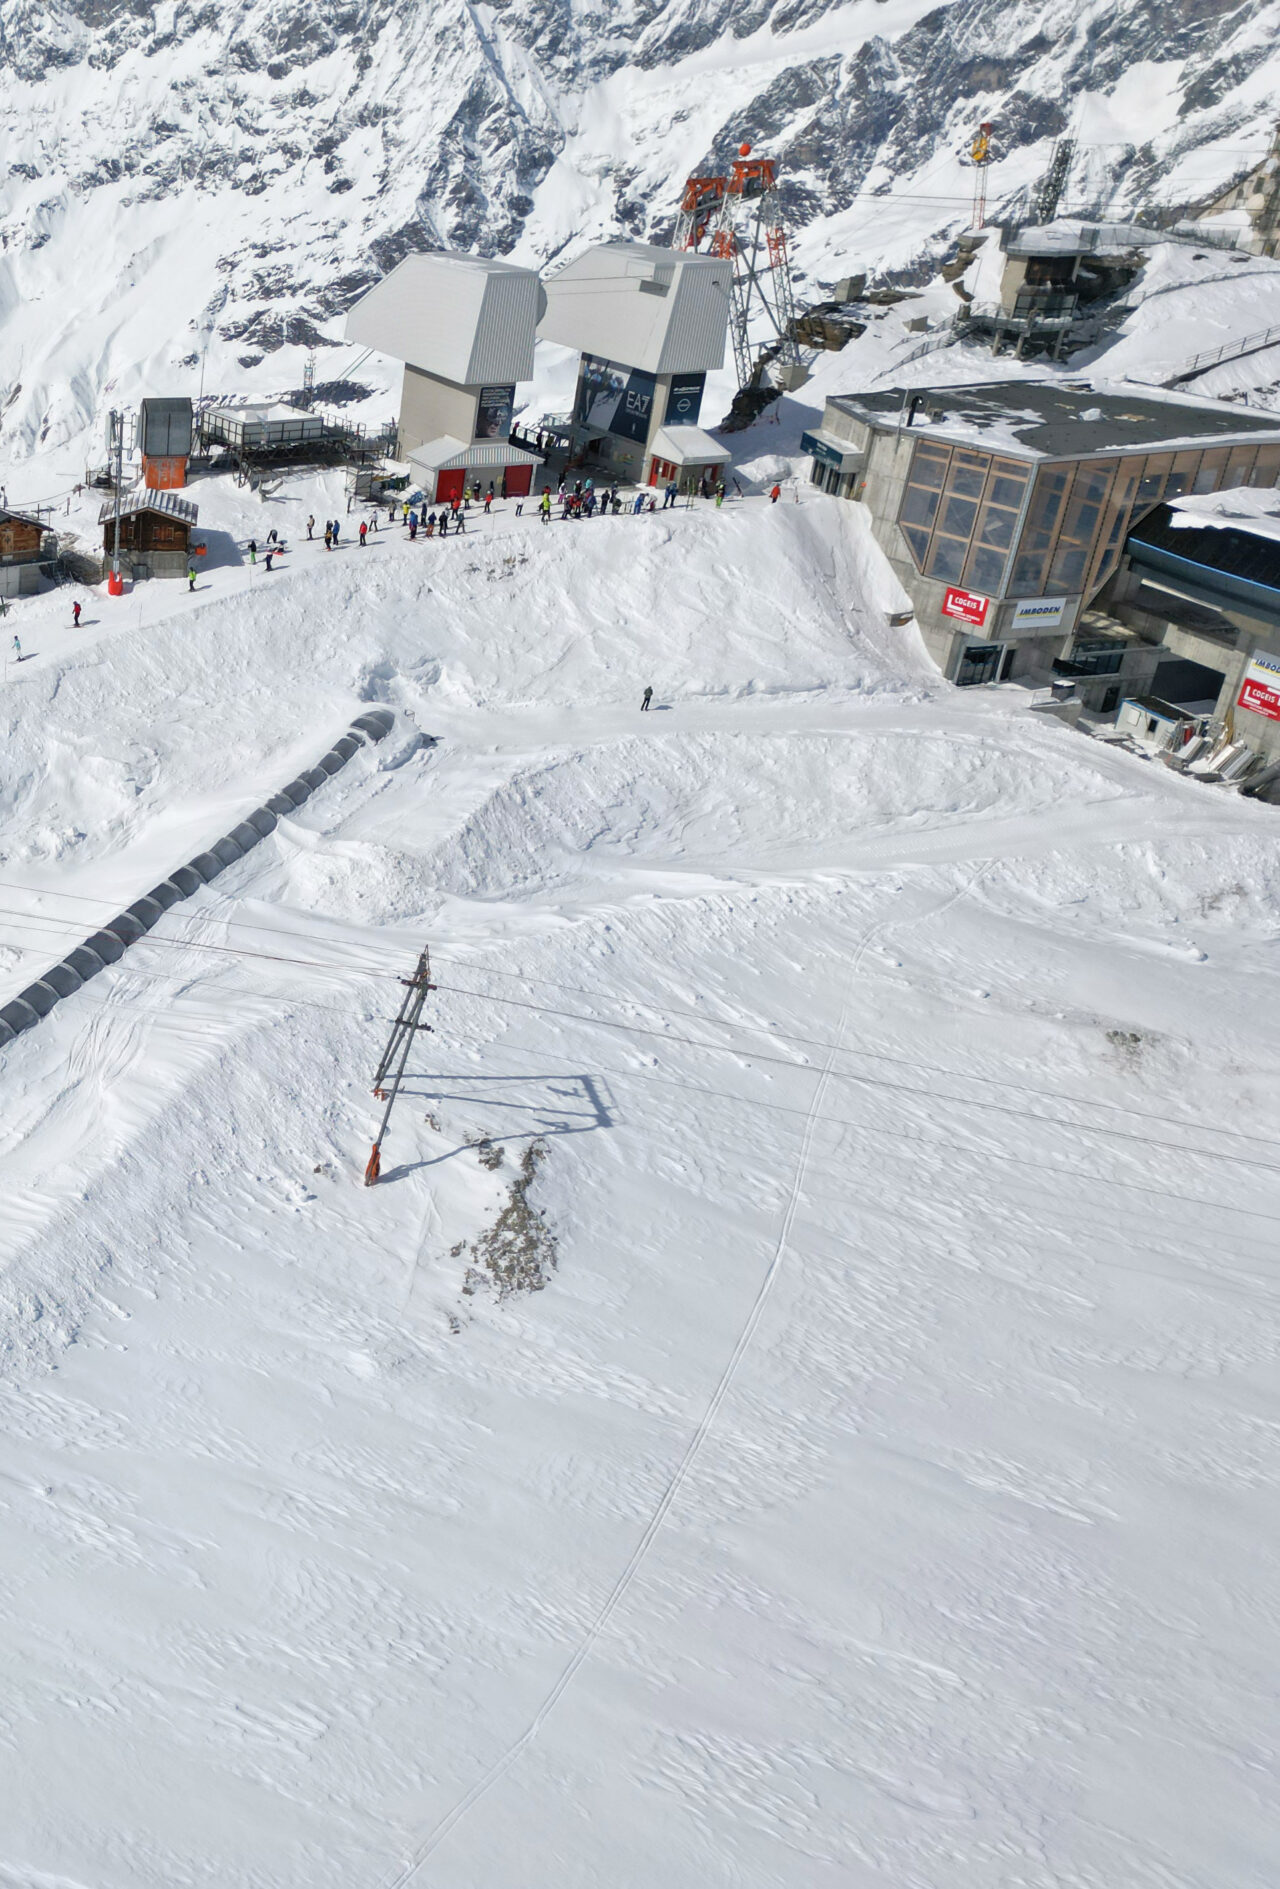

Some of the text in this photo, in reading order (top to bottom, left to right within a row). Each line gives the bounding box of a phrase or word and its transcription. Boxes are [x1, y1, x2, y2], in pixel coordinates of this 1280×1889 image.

[626, 390, 651, 413] EA7
[954, 596, 978, 609] COGEIS
[1020, 605, 1061, 615] IMBODEN
[1252, 688, 1276, 704] COGEIS
